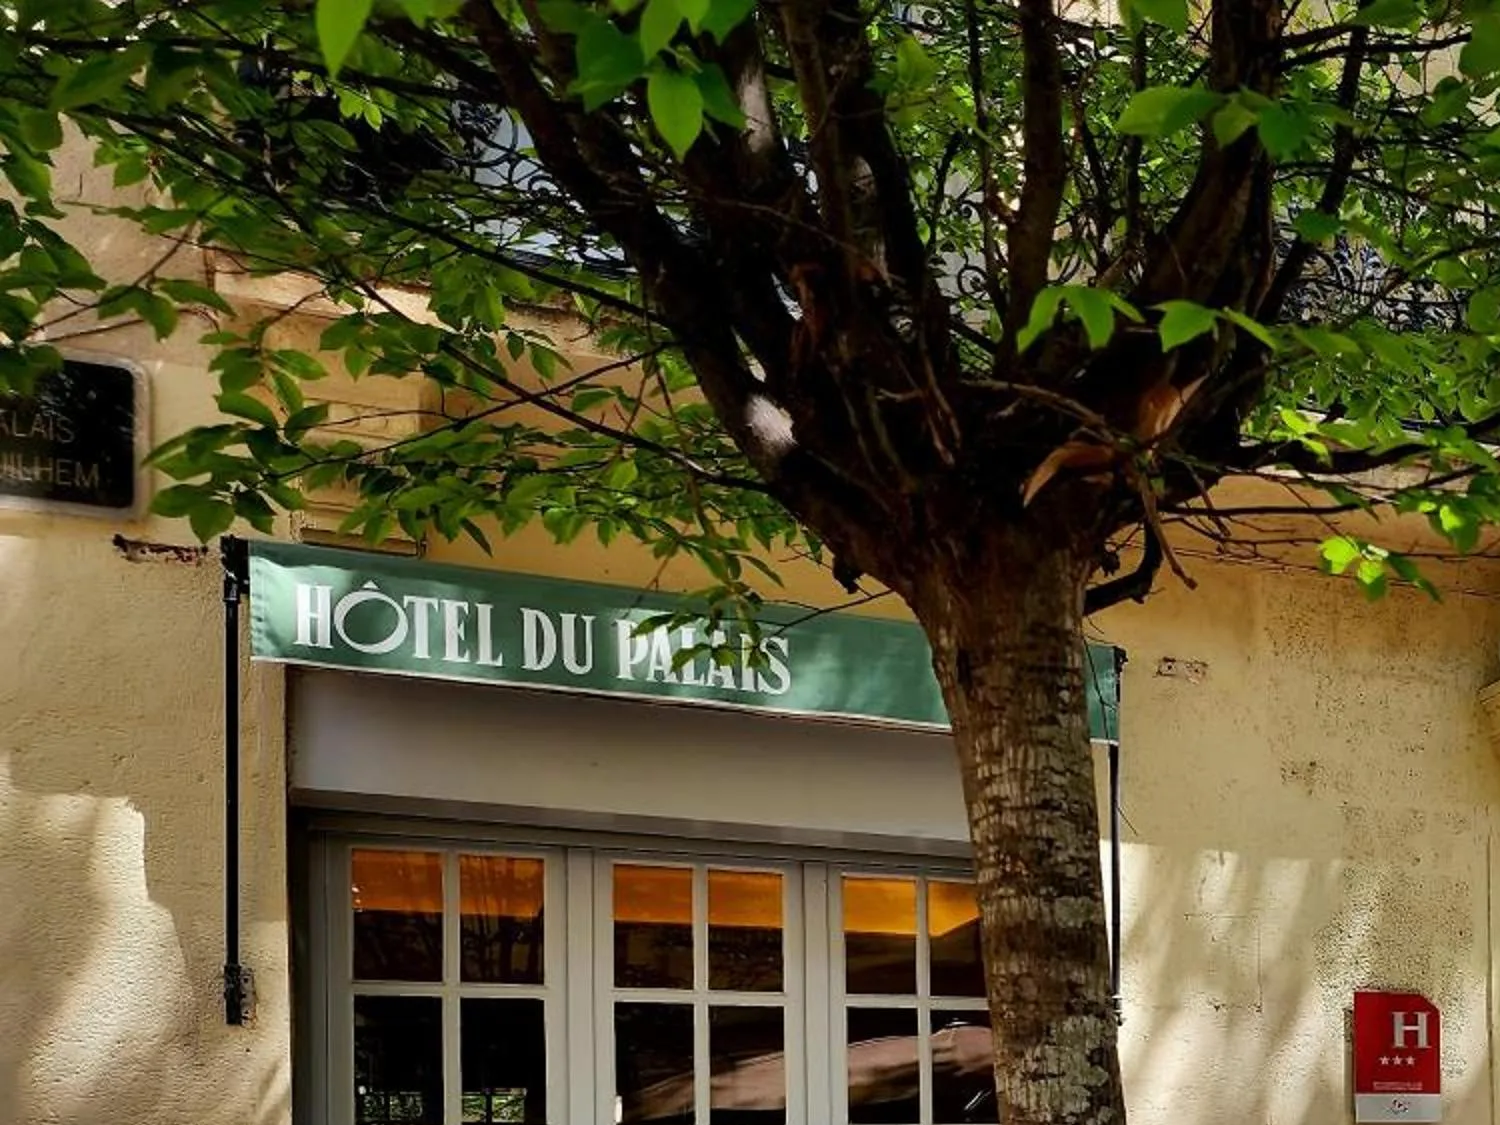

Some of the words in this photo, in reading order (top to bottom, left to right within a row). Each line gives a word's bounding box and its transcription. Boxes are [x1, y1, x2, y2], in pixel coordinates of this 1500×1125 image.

[293, 580, 504, 668] HÔTEL
[519, 607, 597, 676] DU
[1391, 1011, 1432, 1049] H
